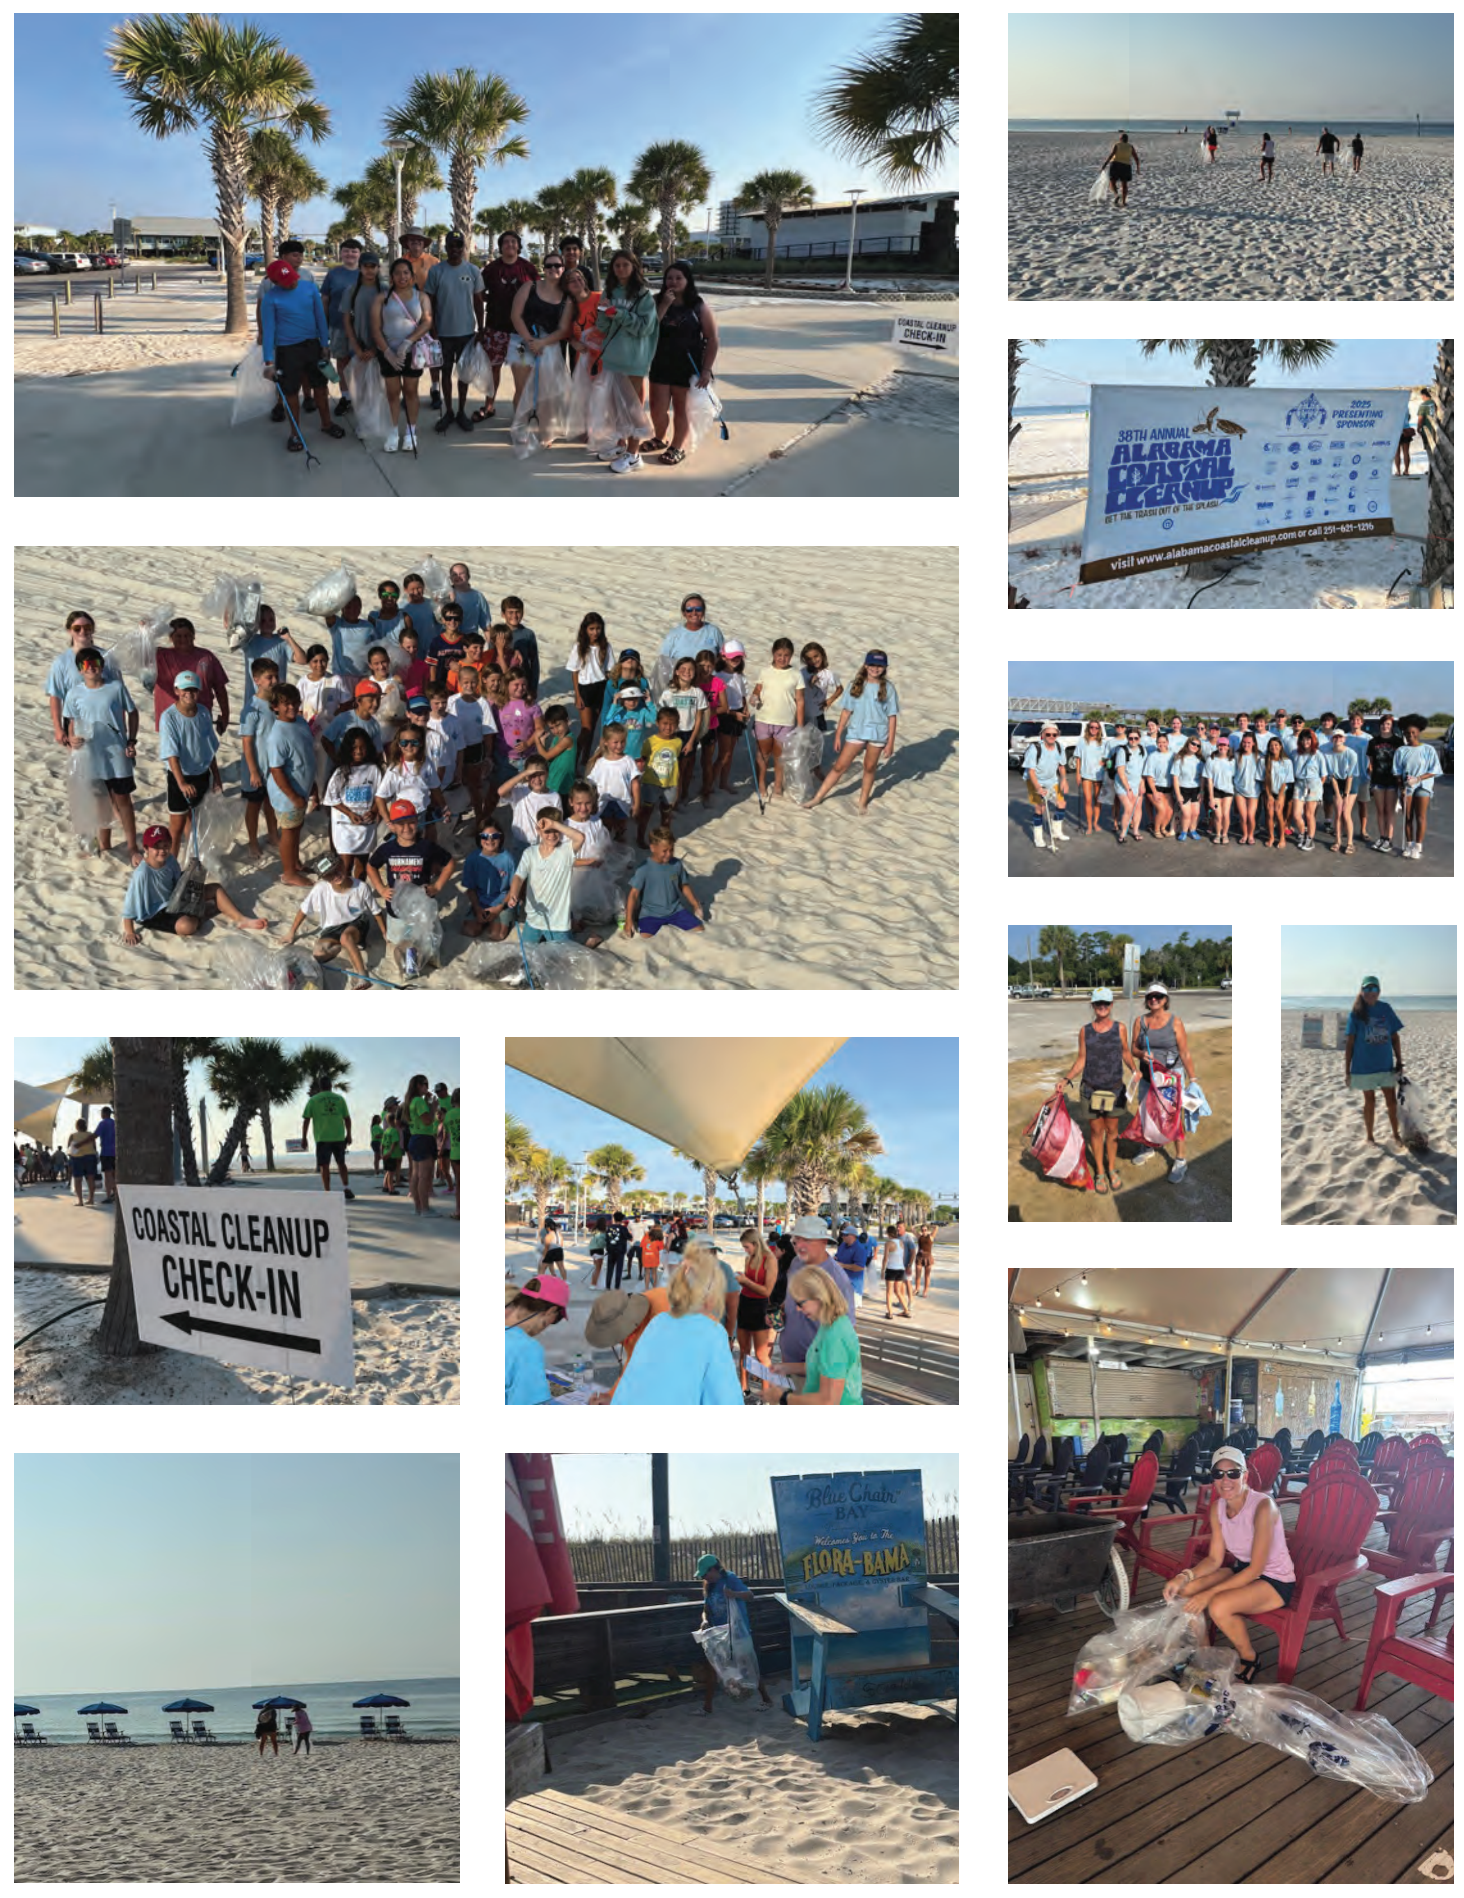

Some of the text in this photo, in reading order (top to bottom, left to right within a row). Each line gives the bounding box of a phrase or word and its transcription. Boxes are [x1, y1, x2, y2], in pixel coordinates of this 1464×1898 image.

[898, 318, 957, 332] COASTAL CLEANUP
[904, 329, 947, 343] CHECK-IN
[1332, 409, 1384, 419] PRESENTING
[1350, 400, 1372, 408] 2025
[1118, 427, 1191, 443] 38TH ANNUAL
[1336, 420, 1376, 429] SPONSOR
[1110, 438, 1232, 466] ALABAMA
[1107, 456, 1235, 493] COASTAL
[1104, 478, 1233, 515] CLEANUP
[1105, 515, 1117, 524] GET
[1120, 512, 1132, 521] THE
[1135, 509, 1157, 519] TRASH
[1159, 507, 1171, 516] OUT
[1173, 505, 1180, 513] OF
[1195, 500, 1219, 510] SPLASH
[1110, 522, 1375, 571] visit www.alabamacoastalcleanup.com or call 251-621-1216
[132, 1207, 329, 1258] COASTAL CLEANUP
[162, 1255, 302, 1319] CHECK-IN
[805, 1484, 847, 1511] Blue
[835, 1504, 869, 1521] BAY
[814, 1528, 895, 1547] Welcomes You to The
[802, 1543, 911, 1583] FLORA-BAMA
